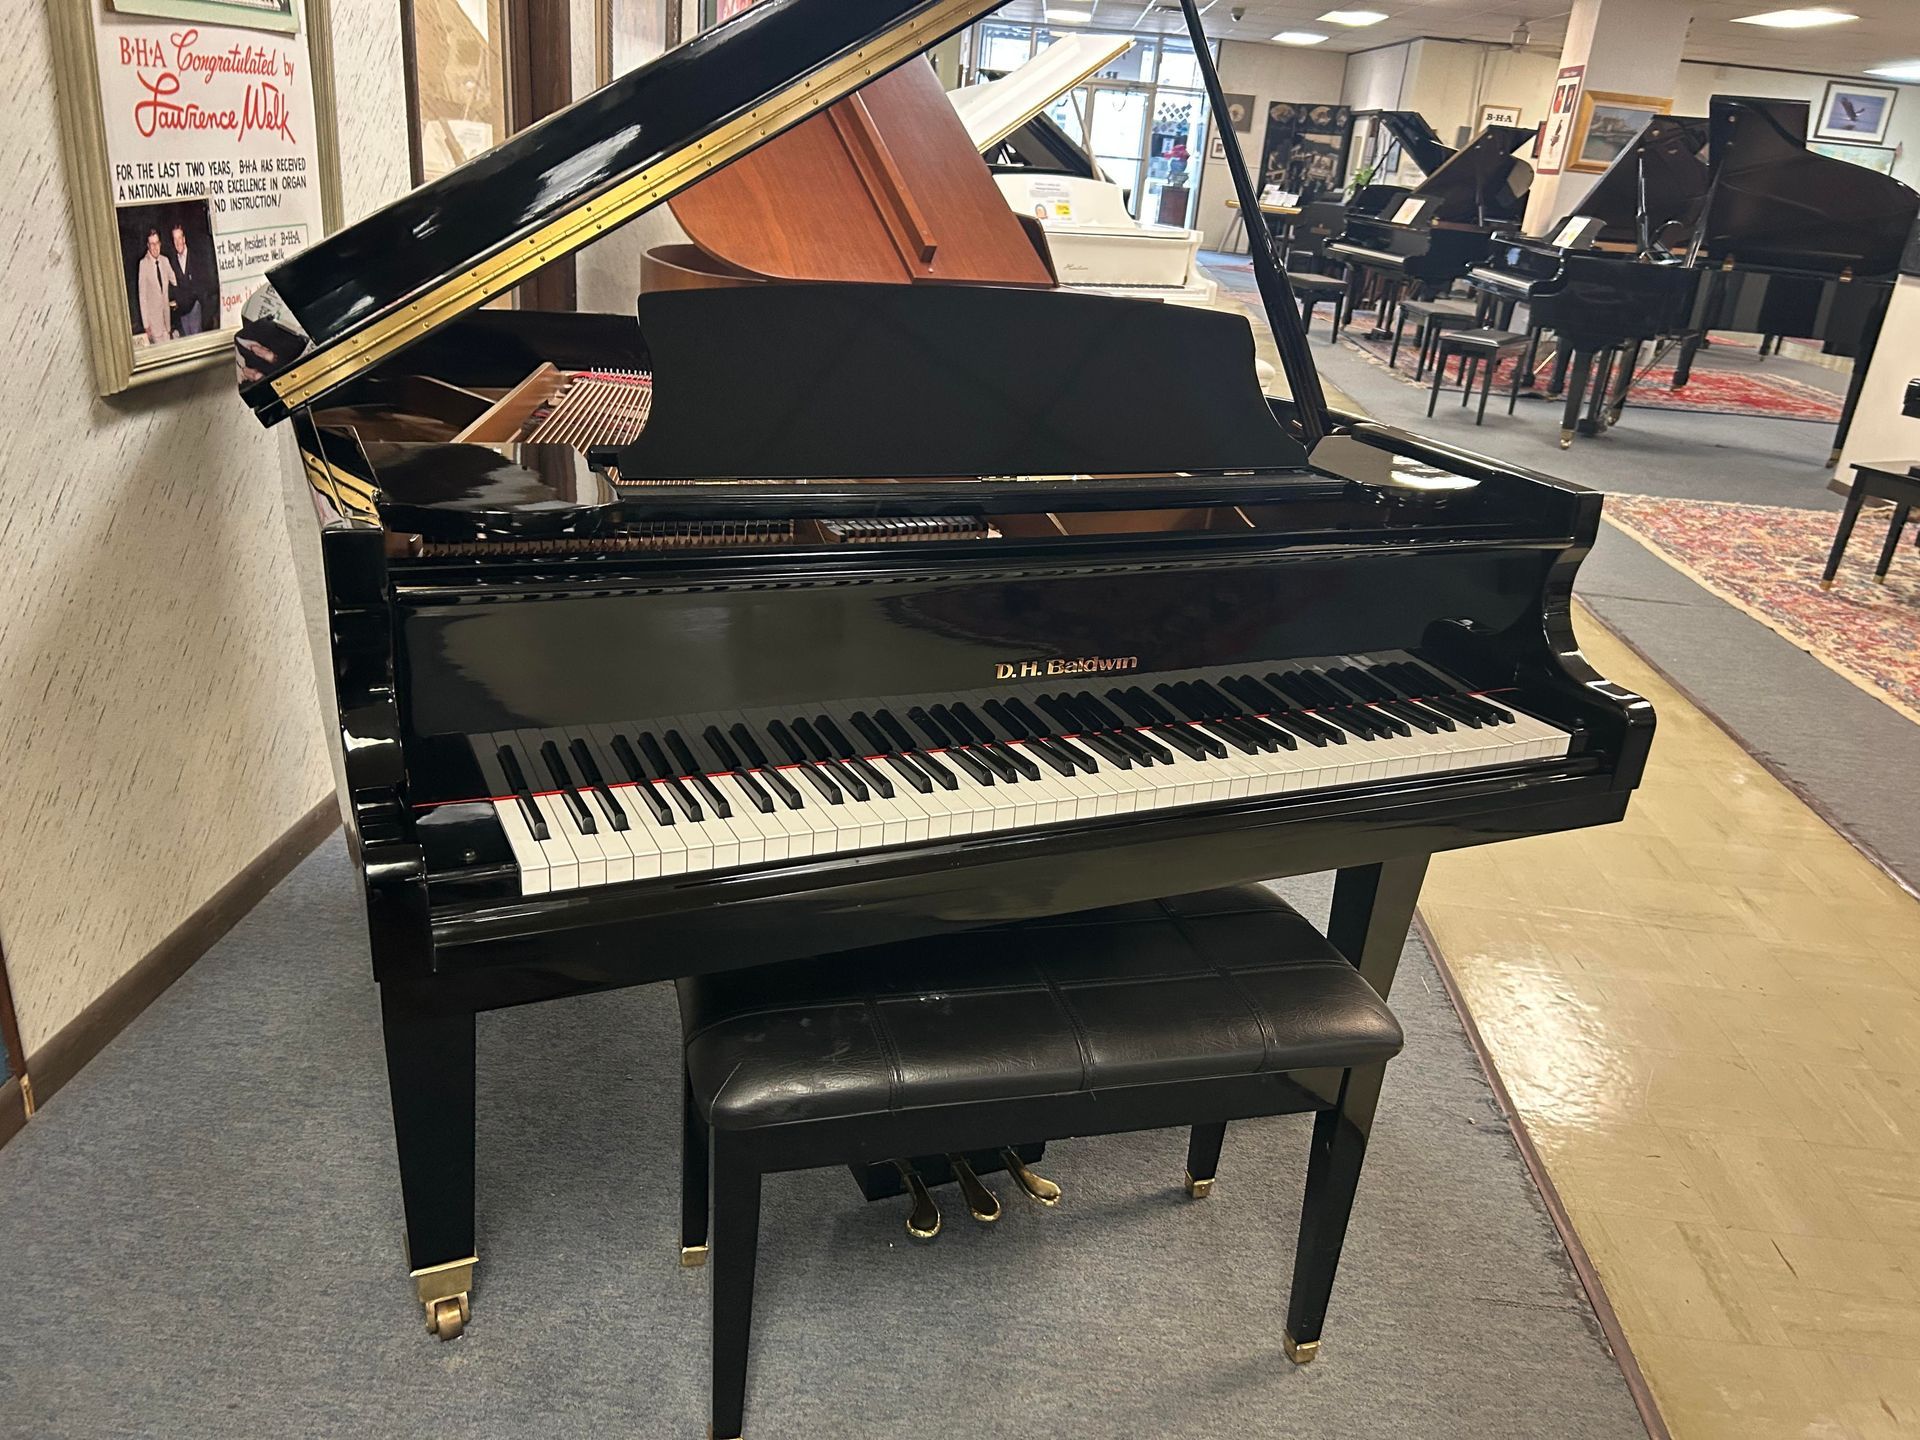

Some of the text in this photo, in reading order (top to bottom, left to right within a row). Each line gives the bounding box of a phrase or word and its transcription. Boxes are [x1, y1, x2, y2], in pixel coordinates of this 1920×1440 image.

[170, 29, 279, 84] Congratulated
[283, 52, 295, 86] by
[134, 70, 297, 144] Lawrence Welk
[116, 164, 134, 180] FOR
[136, 162, 155, 179] THE
[158, 161, 180, 178] LAST
[185, 161, 205, 177] TWO
[208, 160, 234, 178] YEARS,
[261, 158, 274, 172] HAS
[276, 157, 306, 172] RECEIVED
[119, 175, 307, 200] A NATIONAL AWARD FOR EXCELLENCE IN ORGAN
[213, 198, 226, 213] ND
[244, 233, 267, 250] President
[269, 233, 276, 247] of
[219, 248, 285, 271] lated by Lawrence Welk
[1046, 656, 1138, 676] Baldwin
